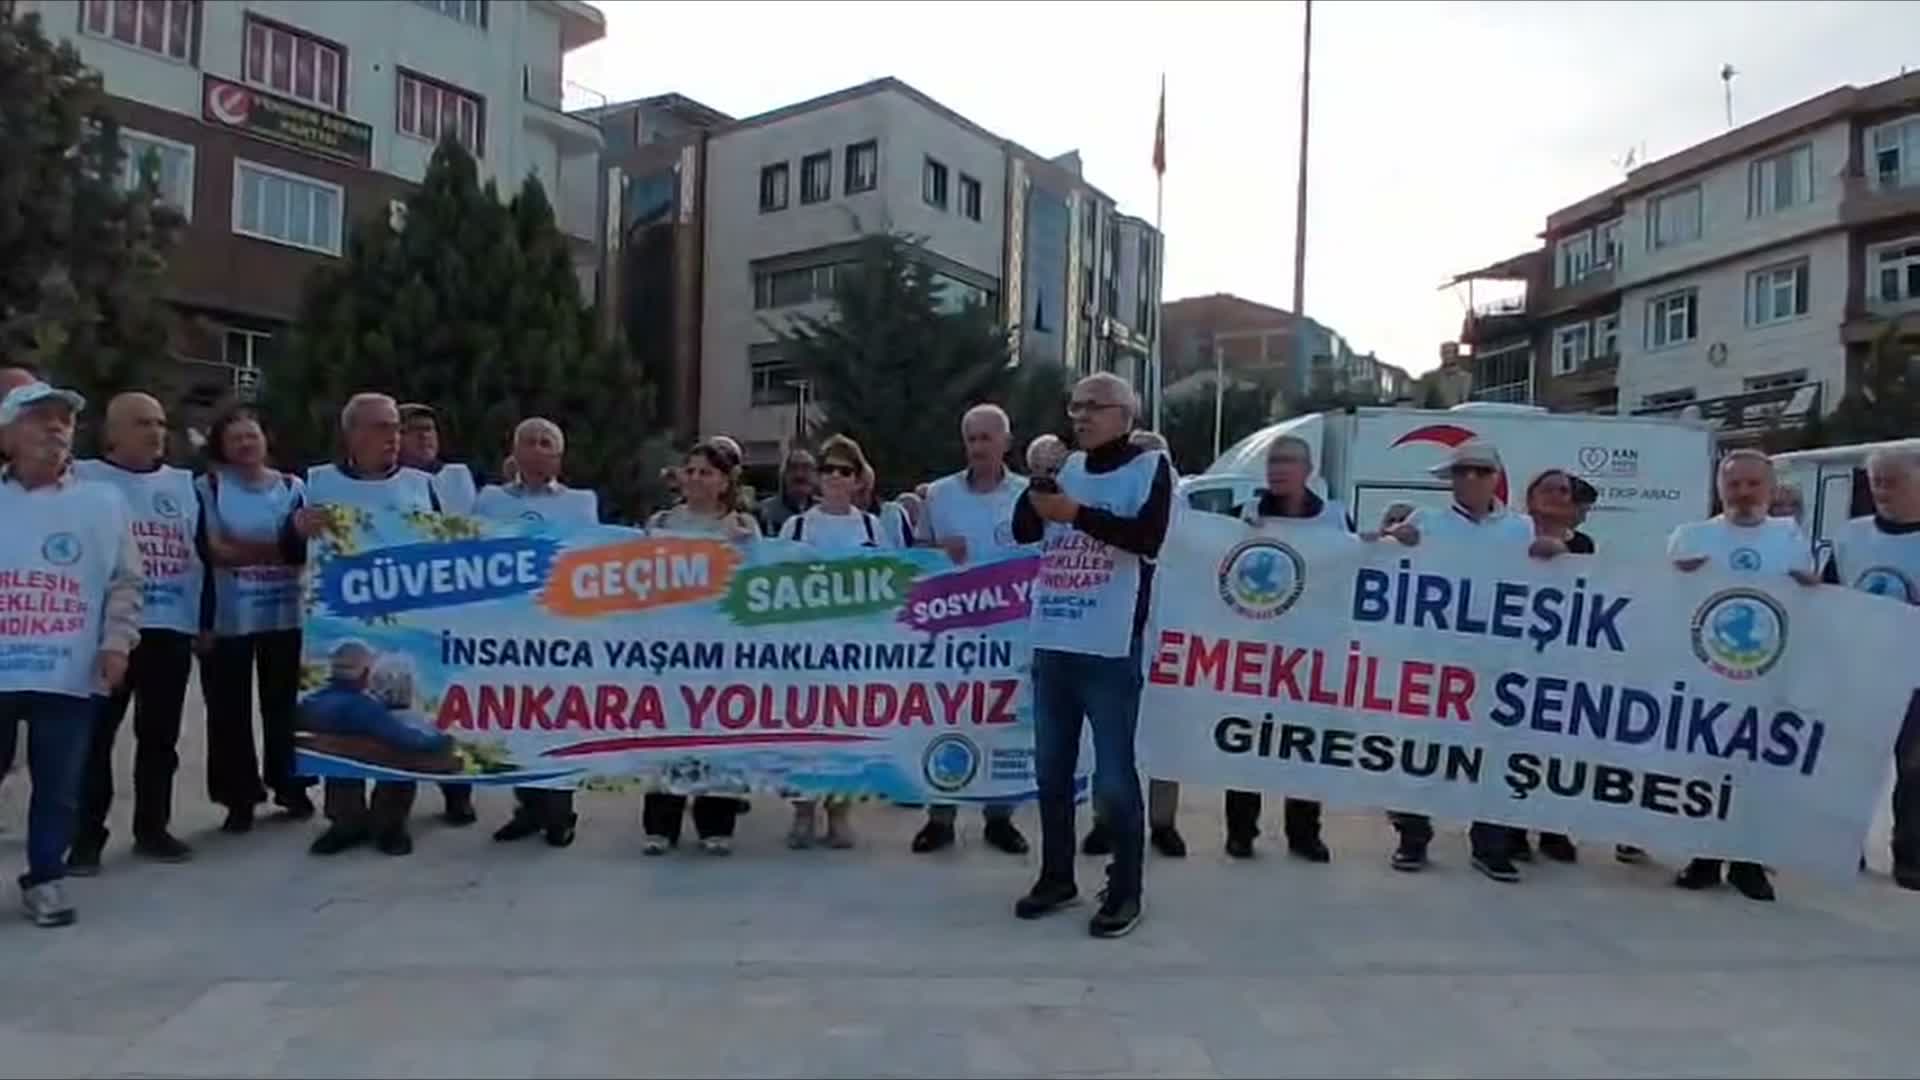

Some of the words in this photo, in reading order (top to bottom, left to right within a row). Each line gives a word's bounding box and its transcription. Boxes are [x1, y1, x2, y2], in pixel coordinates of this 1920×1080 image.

[341, 549, 537, 604] GÜVENCE
[571, 547, 710, 601] GEÇİM
[748, 563, 896, 612] SAĞLIK
[912, 583, 1003, 624] SOSYAL
[1352, 558, 1631, 653] BİRLEŞİK
[441, 629, 592, 668] İNSANCA
[605, 641, 723, 676] YAŞAM
[736, 641, 935, 671] HAKLARIMIZ
[945, 634, 1012, 676] İÇİN
[437, 684, 664, 731] ANKARA
[681, 679, 1020, 729] YOLUNDAYIZ
[1148, 630, 1477, 723] EMEKLİLER
[1490, 671, 1827, 776] SENDİKASI
[1214, 712, 1484, 784] GİRESUN
[1504, 751, 1733, 822] ŞUBESİ
